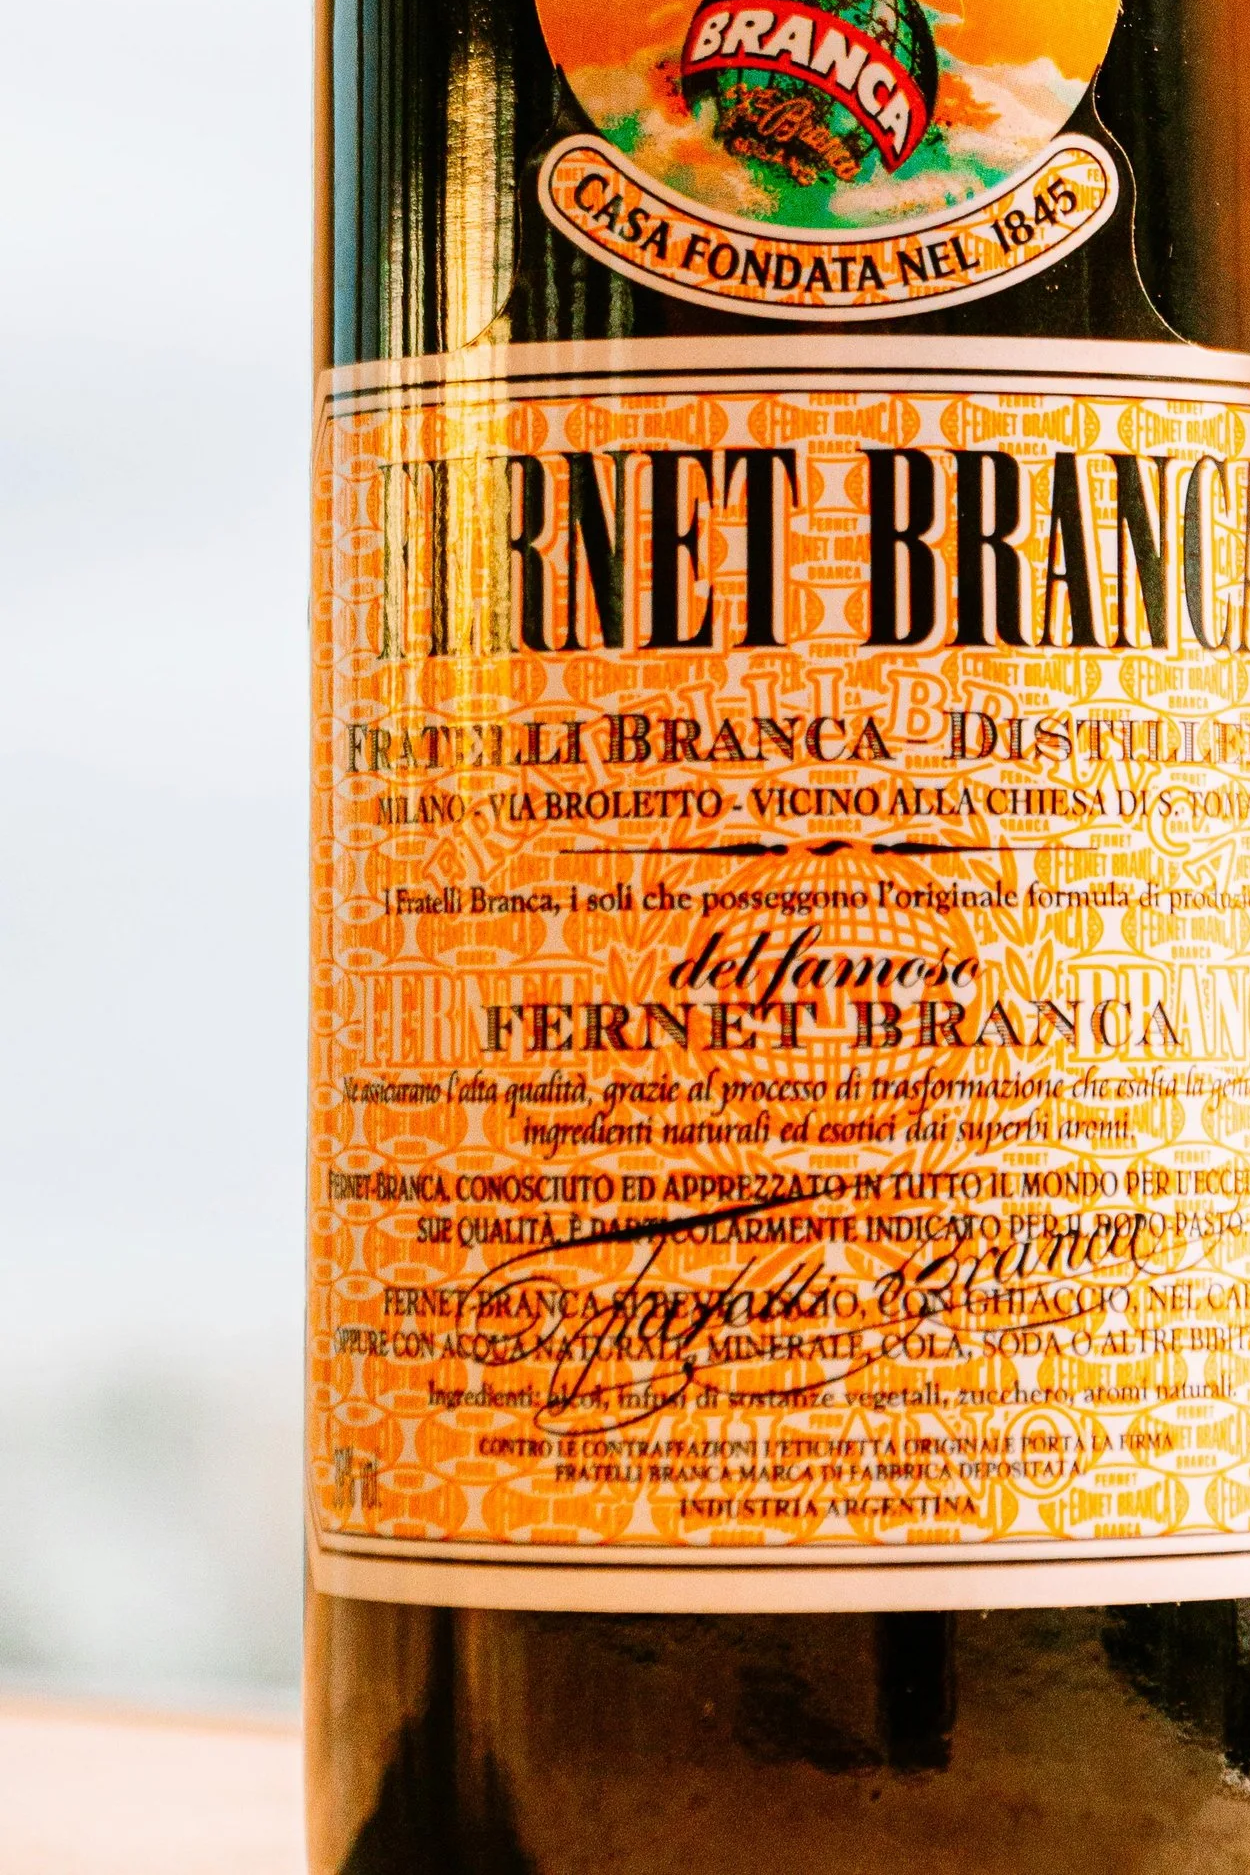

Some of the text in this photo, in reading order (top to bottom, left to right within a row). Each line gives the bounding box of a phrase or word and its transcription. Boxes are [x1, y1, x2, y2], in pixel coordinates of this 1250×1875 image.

[691, 7, 914, 157] BRANCA
[573, 171, 1080, 295] CASA FONDATA NEL 1845
[602, 712, 897, 765] BRANCA
[377, 793, 466, 825] MILANO
[488, 790, 535, 823] VIA
[546, 787, 723, 821] BROLETTO
[752, 786, 881, 819] VICINO
[889, 786, 977, 816] ALLA
[986, 786, 1107, 816] CHIESA
[1119, 789, 1149, 817] DI
[1158, 790, 1181, 818] S.
[396, 886, 462, 916] Fratelli
[471, 883, 561, 916] Branca,
[570, 882, 578, 912] i
[587, 882, 634, 911] soli
[642, 882, 694, 911] che
[701, 885, 869, 918] posseggono
[877, 880, 1020, 915] l'originale
[1028, 880, 1130, 909] formula
[1139, 880, 1161, 909] di
[668, 931, 762, 990] del
[758, 923, 987, 1009] famoso
[480, 998, 1187, 1054] FERNET BRANCA
[446, 1069, 498, 1104] l'alta
[506, 1070, 593, 1118] qualità,
[602, 1072, 681, 1117] grazie
[688, 1067, 716, 1103] al
[720, 1076, 827, 1114] processo
[835, 1067, 862, 1101] di
[870, 1067, 1064, 1115] trasformazione
[1072, 1065, 1109, 1099] che
[1115, 1065, 1178, 1099] esalta
[1184, 1064, 1206, 1099] la
[523, 1115, 653, 1160] ingredienti
[662, 1110, 771, 1145] naturali
[779, 1109, 809, 1143] ed
[818, 1109, 898, 1144] esotici
[904, 1109, 948, 1143] dai
[955, 1108, 1050, 1156] superbi
[455, 1174, 615, 1203] CONOSCIUTO
[622, 1174, 656, 1203] ED
[662, 1172, 850, 1203] APPREZZATO
[854, 1172, 881, 1200] IN
[891, 1171, 983, 1200] TUTTO
[989, 1171, 1014, 1198] IL
[1021, 1170, 1118, 1199] MONDO
[1127, 1170, 1170, 1196] PER
[416, 1216, 453, 1245] SUE
[866, 1214, 1001, 1243] INDICATO
[383, 1285, 600, 1320] FERNET-BRANCA
[965, 1286, 1138, 1316] GHIACCIO,
[1149, 1283, 1200, 1312] NEL
[392, 1330, 436, 1358] CON
[881, 1331, 973, 1362] COLA,
[981, 1331, 1063, 1359] SODA
[1071, 1328, 1092, 1357] O
[1100, 1327, 1182, 1356] ALTRE
[427, 1380, 541, 1415] Ingredienti:
[696, 1383, 717, 1410] di
[845, 1380, 949, 1412] vegetali,
[958, 1379, 1076, 1406] zucchero,
[1083, 1376, 1147, 1403] aromi
[1156, 1371, 1238, 1400] naturali.
[478, 1436, 553, 1458] CONTRO
[904, 1436, 1014, 1457] ORIGINALE
[1021, 1434, 1085, 1454] PORTA
[1091, 1434, 1115, 1453] LA
[1119, 1432, 1174, 1451] FIRMA
[555, 1462, 643, 1484] FRATELLI
[649, 1462, 731, 1483] BRANCA
[739, 1462, 813, 1483] MARCA
[850, 1462, 952, 1482] FABBRICA
[679, 1495, 982, 1518] INDUSTRIA ARGENTINA
